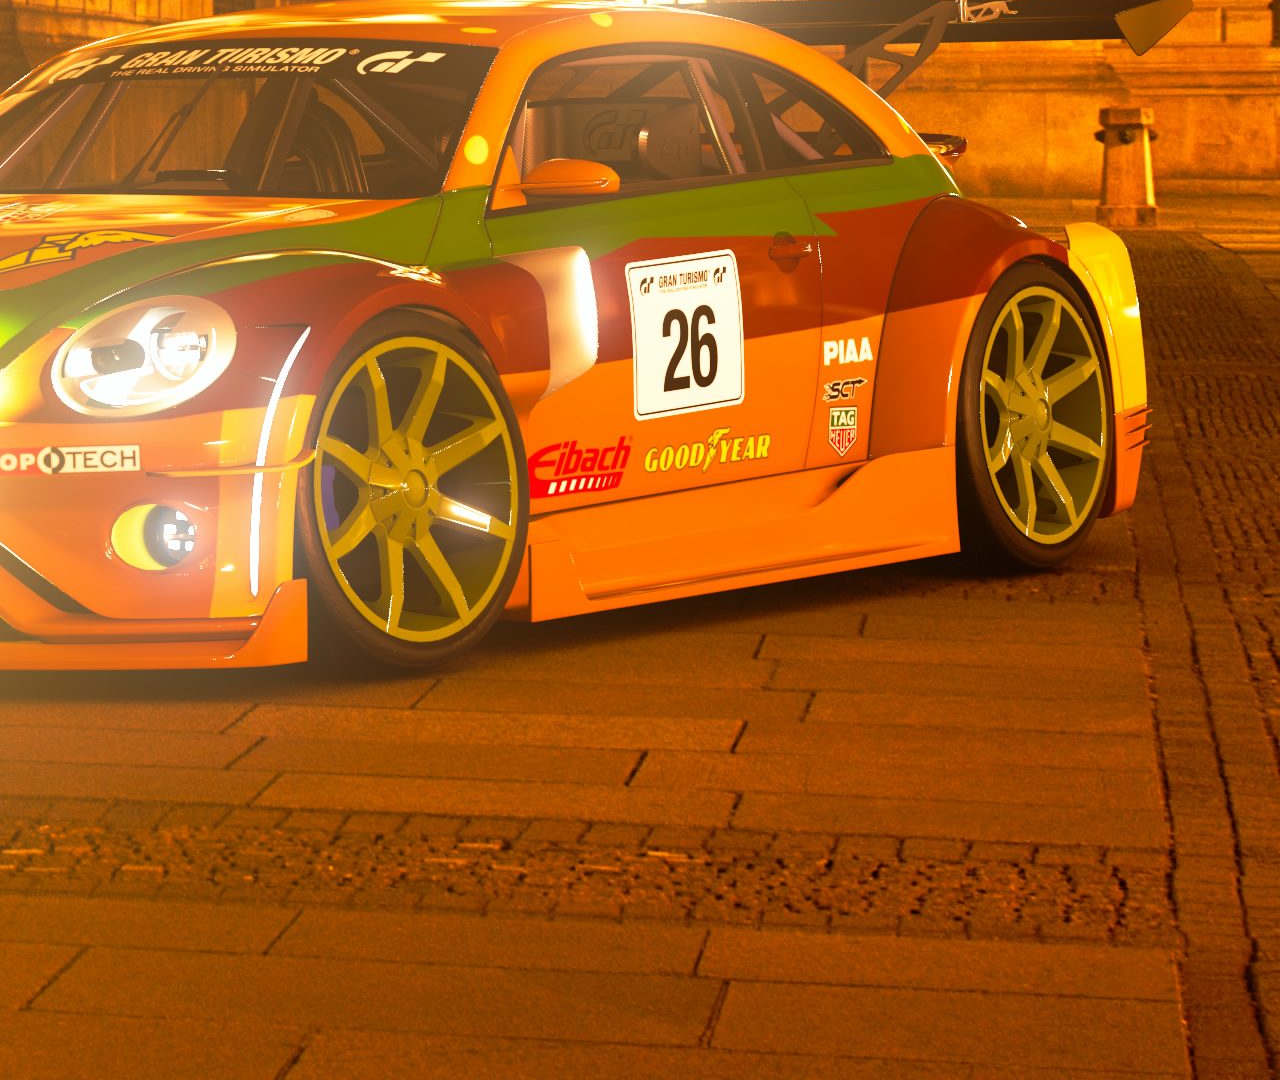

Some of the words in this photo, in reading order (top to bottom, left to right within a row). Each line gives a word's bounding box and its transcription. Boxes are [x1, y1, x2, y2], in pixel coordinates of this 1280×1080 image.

[121, 49, 211, 69] GRAN
[110, 69, 135, 78] THE
[135, 67, 170, 76] REAL
[232, 65, 321, 73] SIMULATOR
[659, 274, 678, 288] GRAN
[662, 304, 719, 393] 26
[823, 336, 874, 366] PIAA
[831, 410, 856, 426] TAG
[830, 428, 856, 452] HEUER
[528, 436, 631, 480] Eibach
